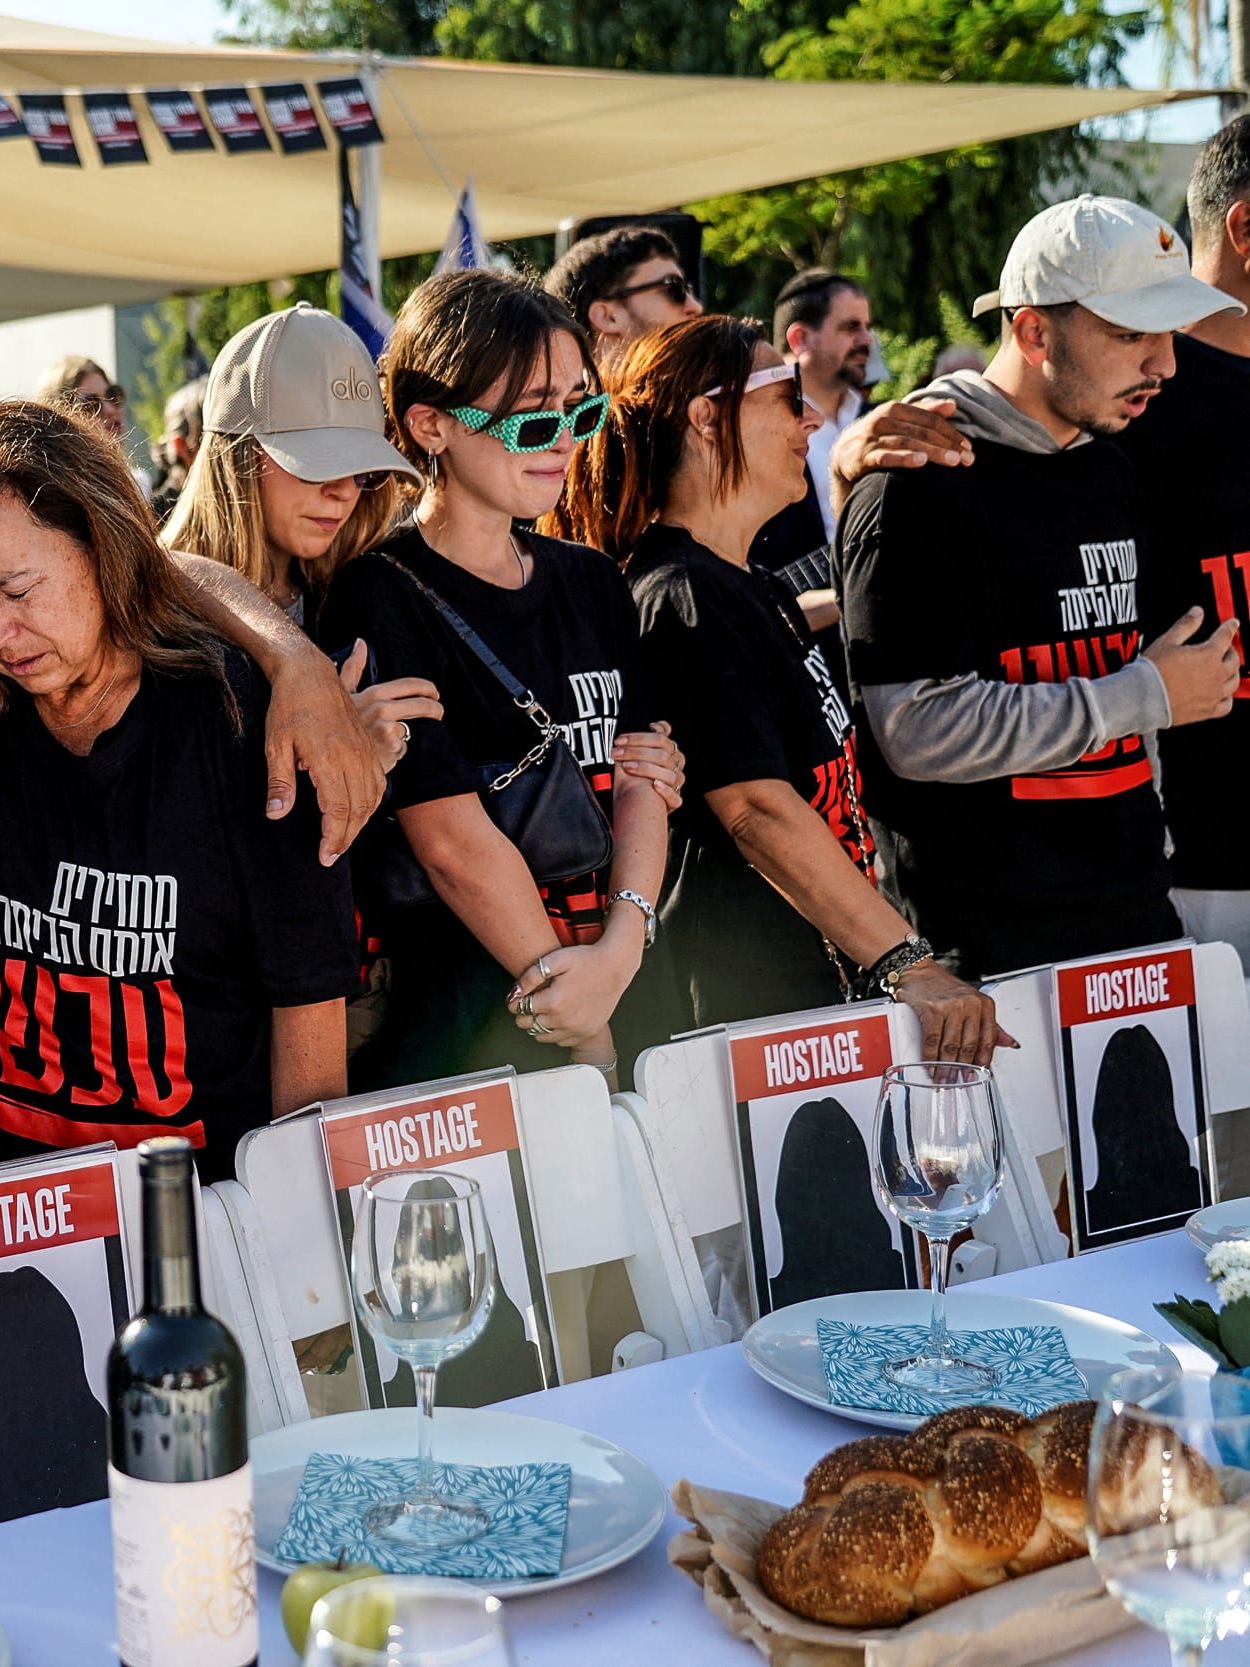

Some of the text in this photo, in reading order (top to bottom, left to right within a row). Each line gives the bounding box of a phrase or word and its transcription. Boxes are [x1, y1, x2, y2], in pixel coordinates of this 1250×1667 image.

[331, 368, 372, 401] alo
[49, 860, 179, 929] מחזירים
[89, 926, 176, 977] אותם
[1085, 962, 1170, 1015] HOSTAGE
[763, 1031, 864, 1088] HOSTAGE
[364, 1102, 483, 1172] HOSTAGE
